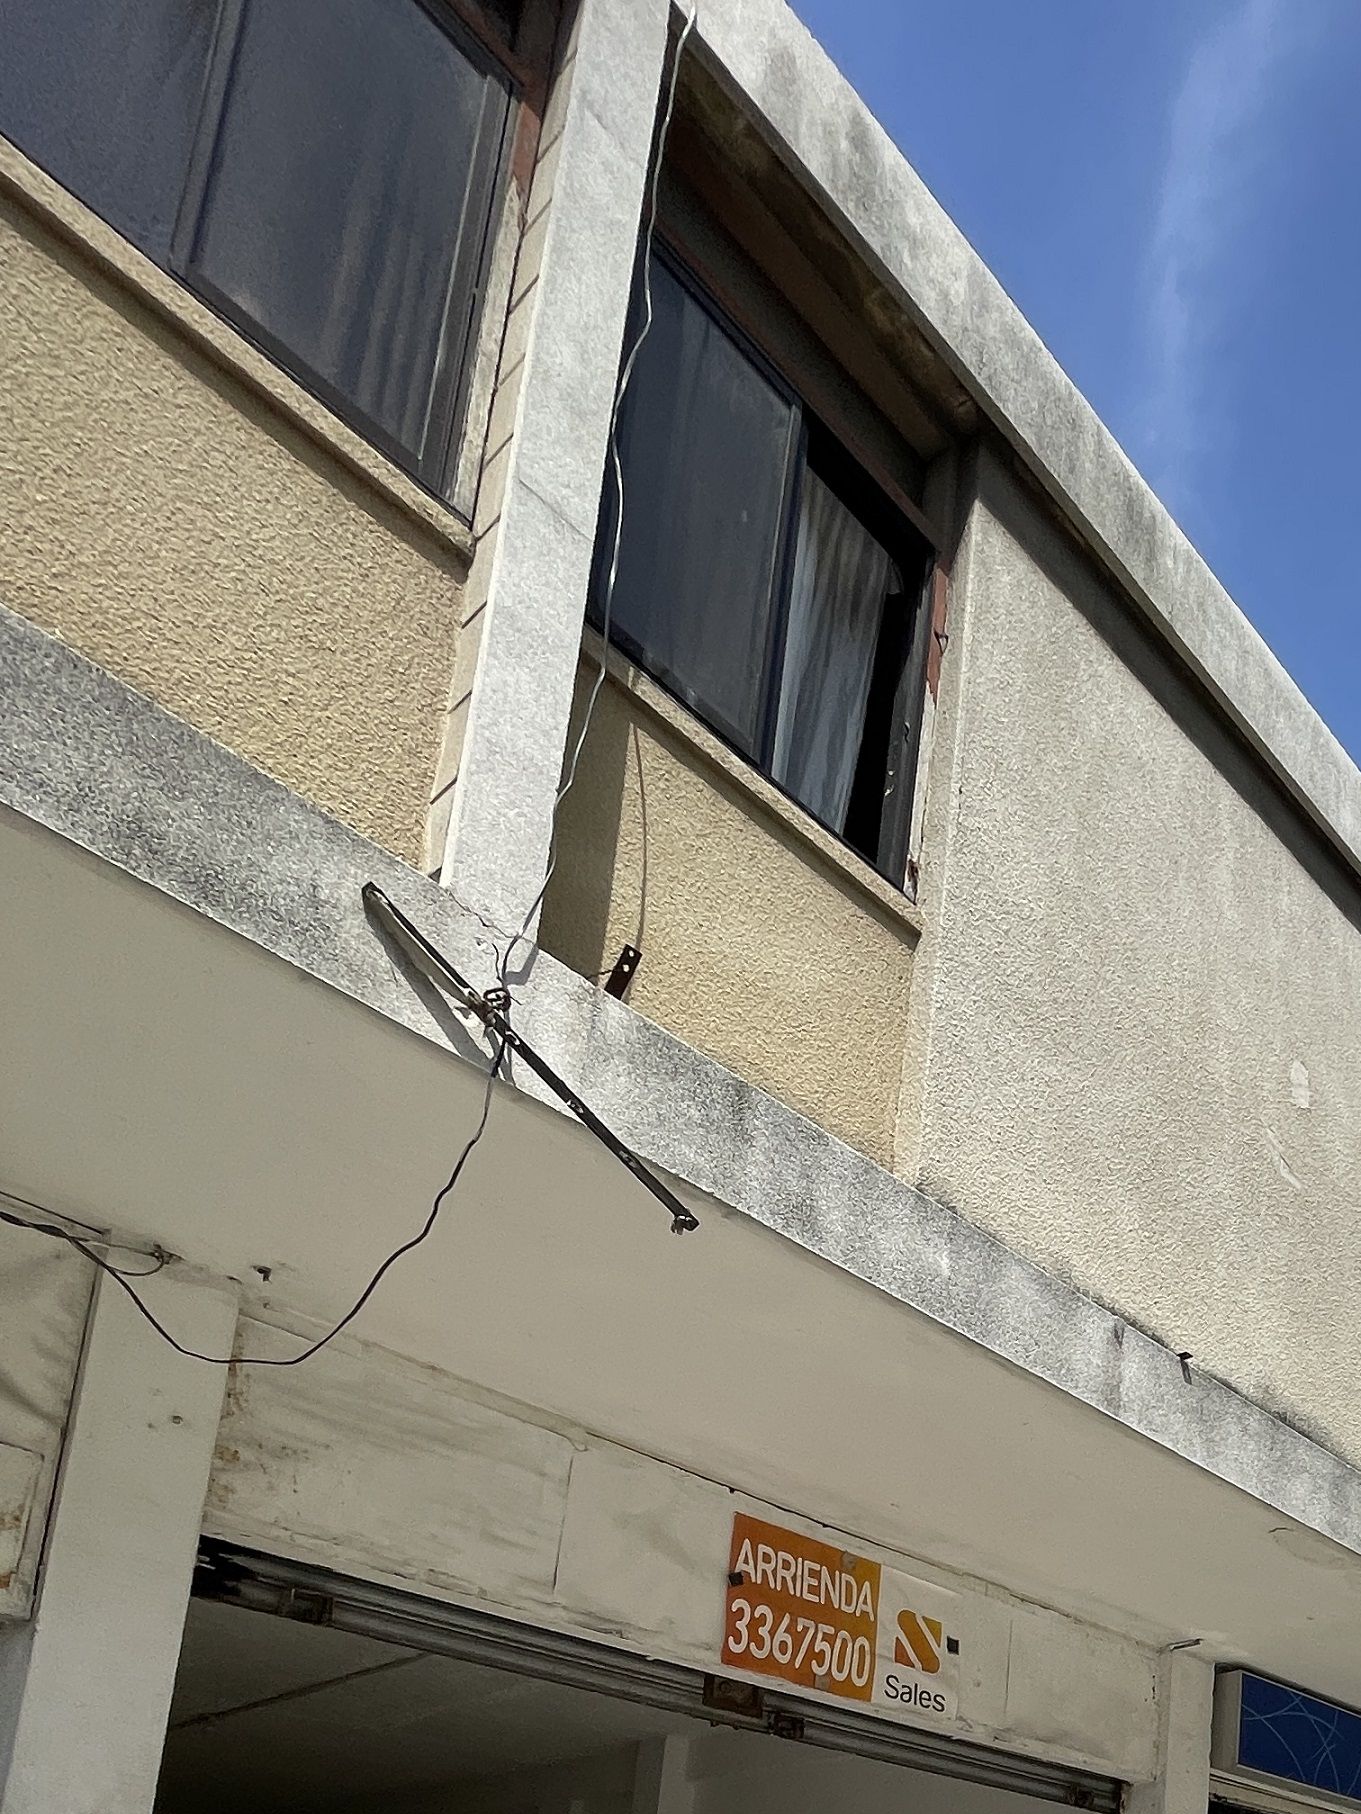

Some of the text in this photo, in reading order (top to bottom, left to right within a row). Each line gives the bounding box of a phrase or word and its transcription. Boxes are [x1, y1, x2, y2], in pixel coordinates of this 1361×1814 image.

[734, 1538, 876, 1622] ARRIENDA
[727, 1598, 871, 1687] 3367500
[884, 1674, 947, 1713] Sales
